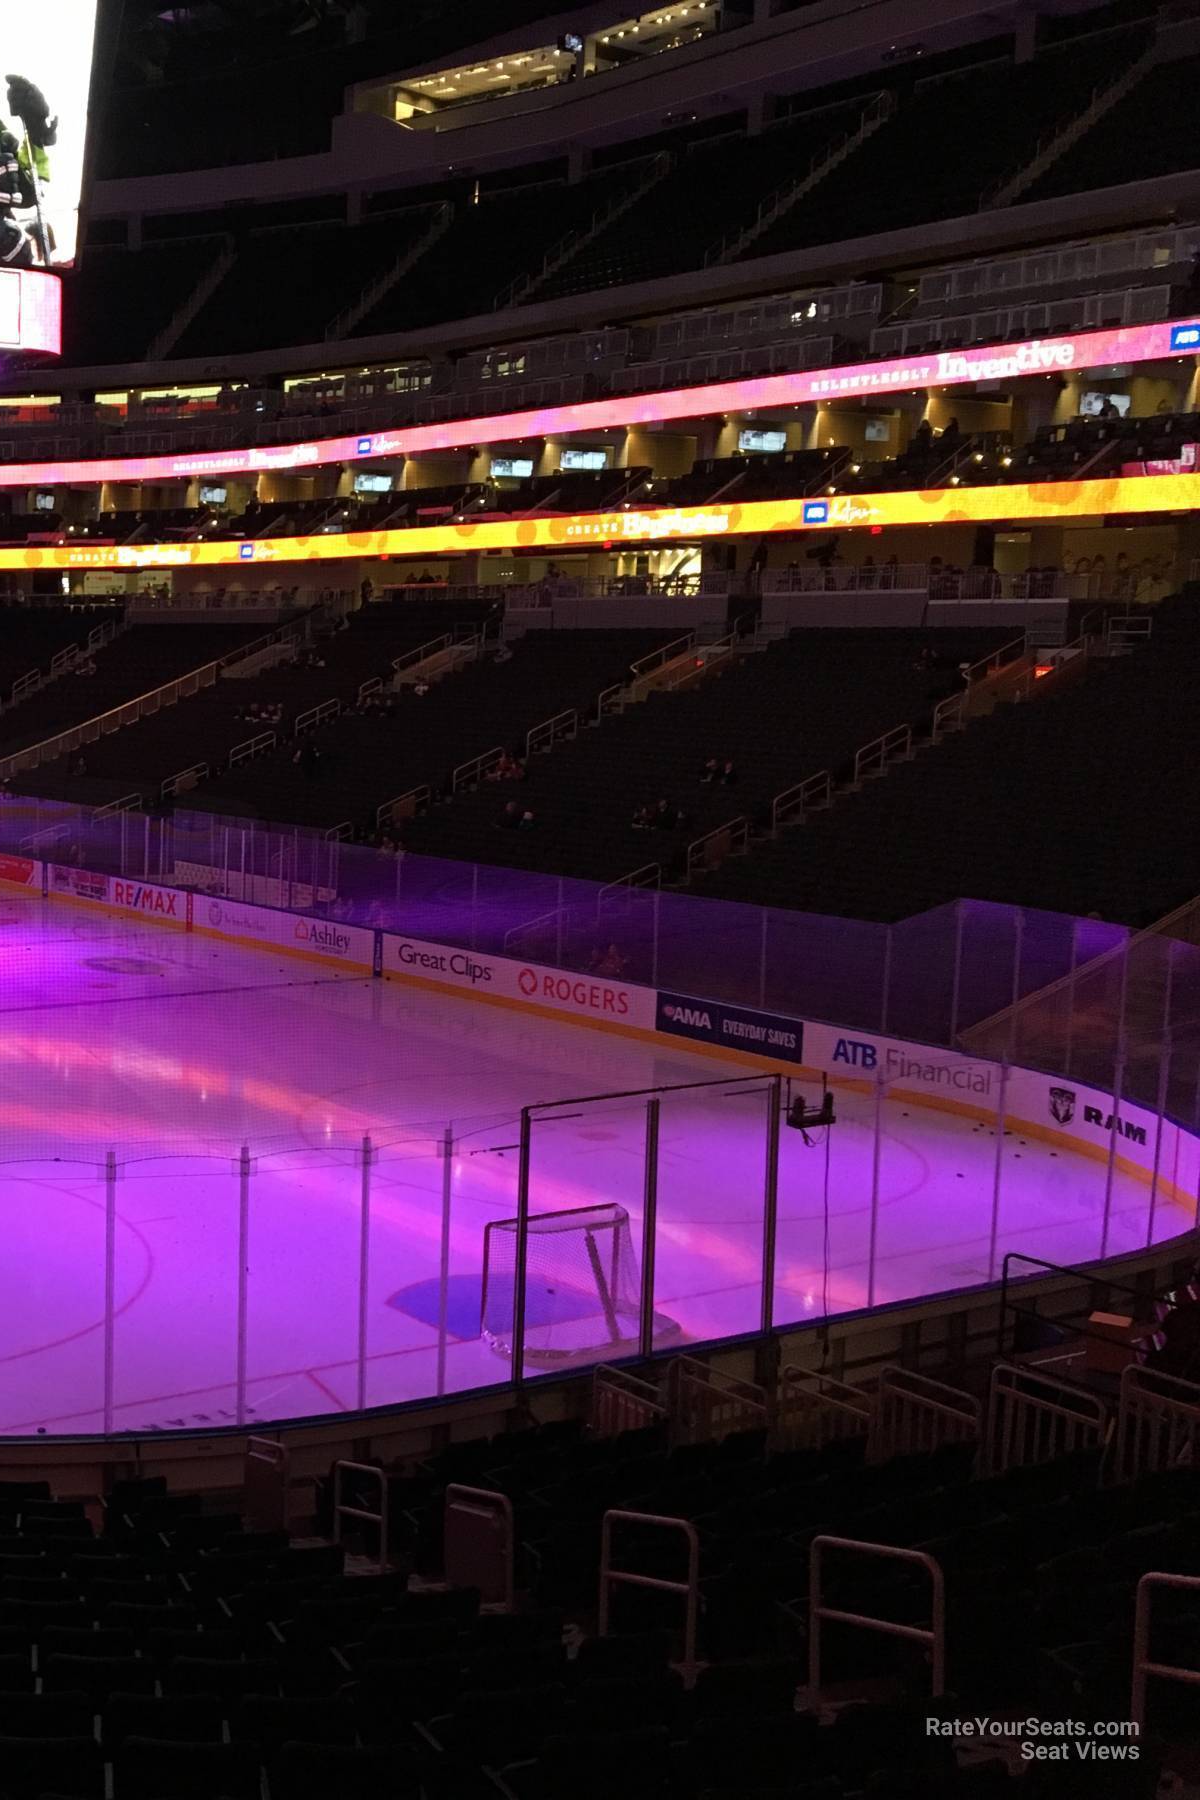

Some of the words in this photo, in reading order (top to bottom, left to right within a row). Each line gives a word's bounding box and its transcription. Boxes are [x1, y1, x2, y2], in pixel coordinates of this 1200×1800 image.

[810, 366, 929, 393] RELENTLESSLY
[936, 340, 1075, 381] Inventive
[114, 880, 177, 916] RE/MAX
[309, 924, 350, 954] Ashley
[398, 943, 447, 972] Great
[450, 953, 493, 985] Clips
[543, 975, 629, 1015] ROGERS
[672, 1006, 712, 1030] AMA
[723, 1019, 768, 1042] EVERYDAY
[767, 1028, 797, 1049] SAVES
[833, 1037, 878, 1070] ATB
[885, 1047, 992, 1096] Financial
[1083, 1104, 1147, 1146] RAM
